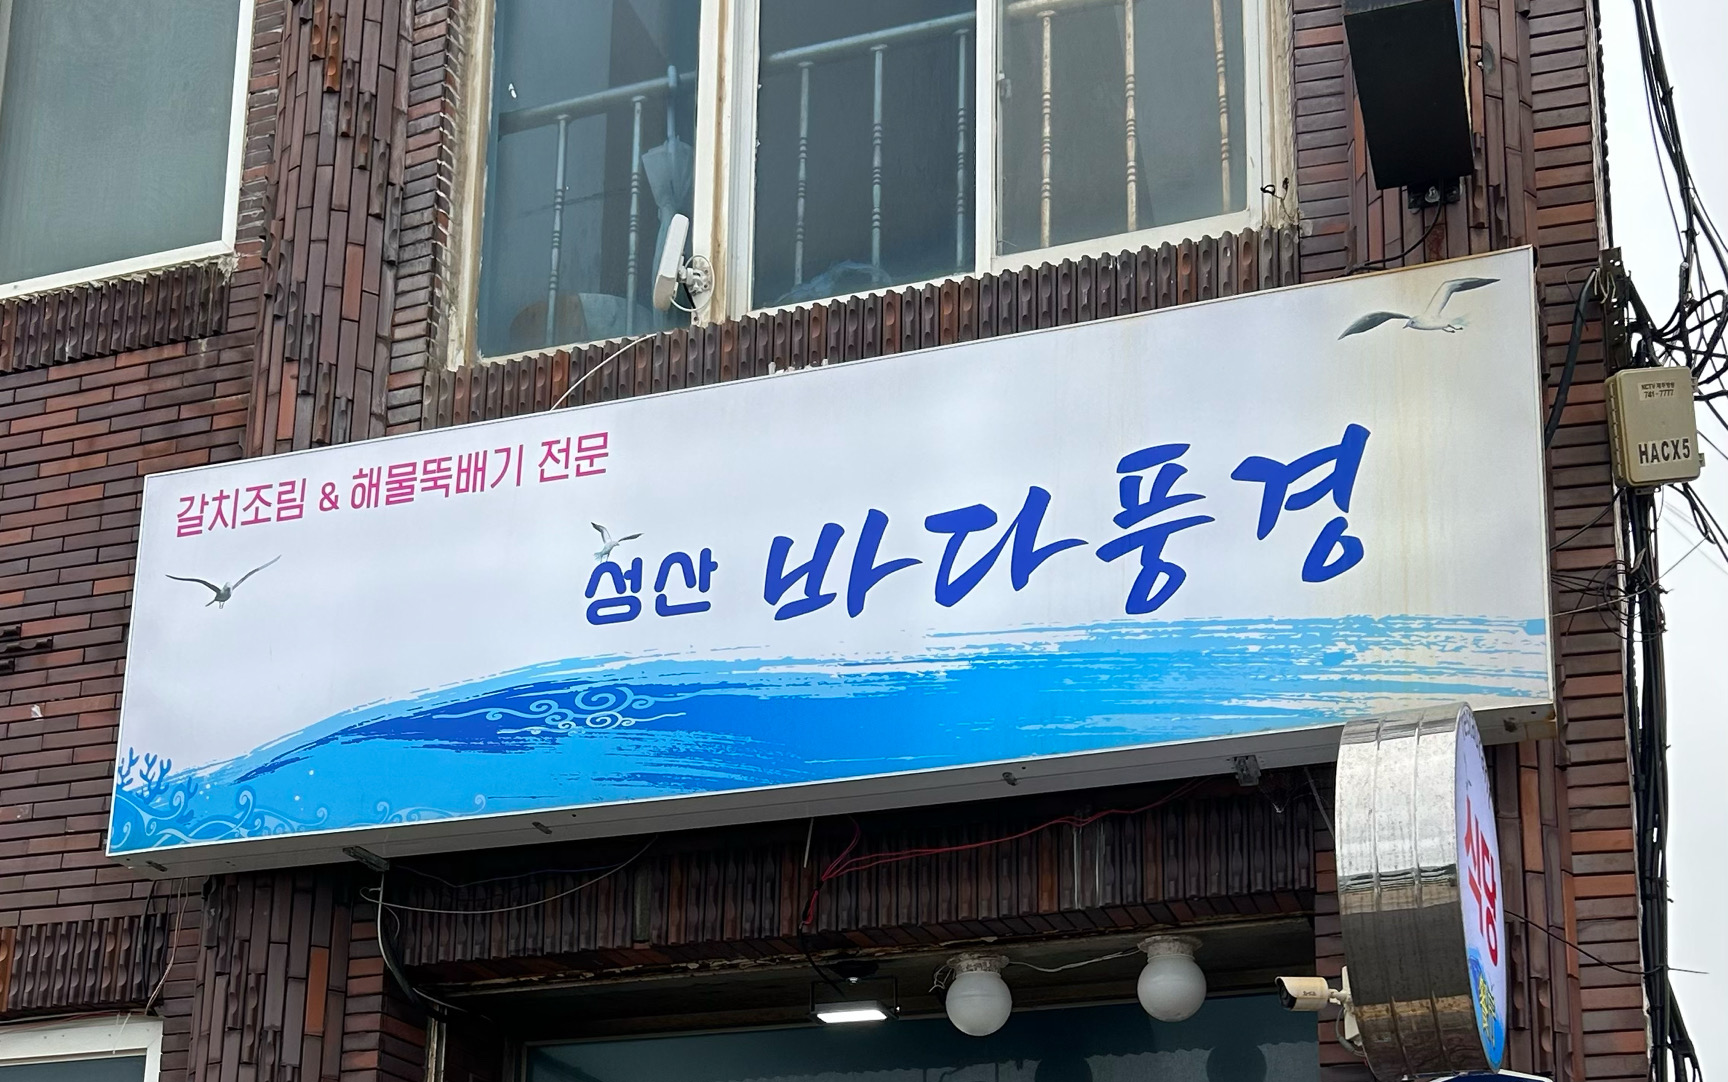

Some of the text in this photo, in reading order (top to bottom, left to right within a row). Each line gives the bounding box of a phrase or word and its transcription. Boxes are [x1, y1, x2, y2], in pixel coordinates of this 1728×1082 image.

[176, 429, 609, 538] 갈치조림 & 해물뚝배기 전문
[1638, 438, 1691, 465] HACX5
[584, 423, 1370, 626] 성산 바다풍경
